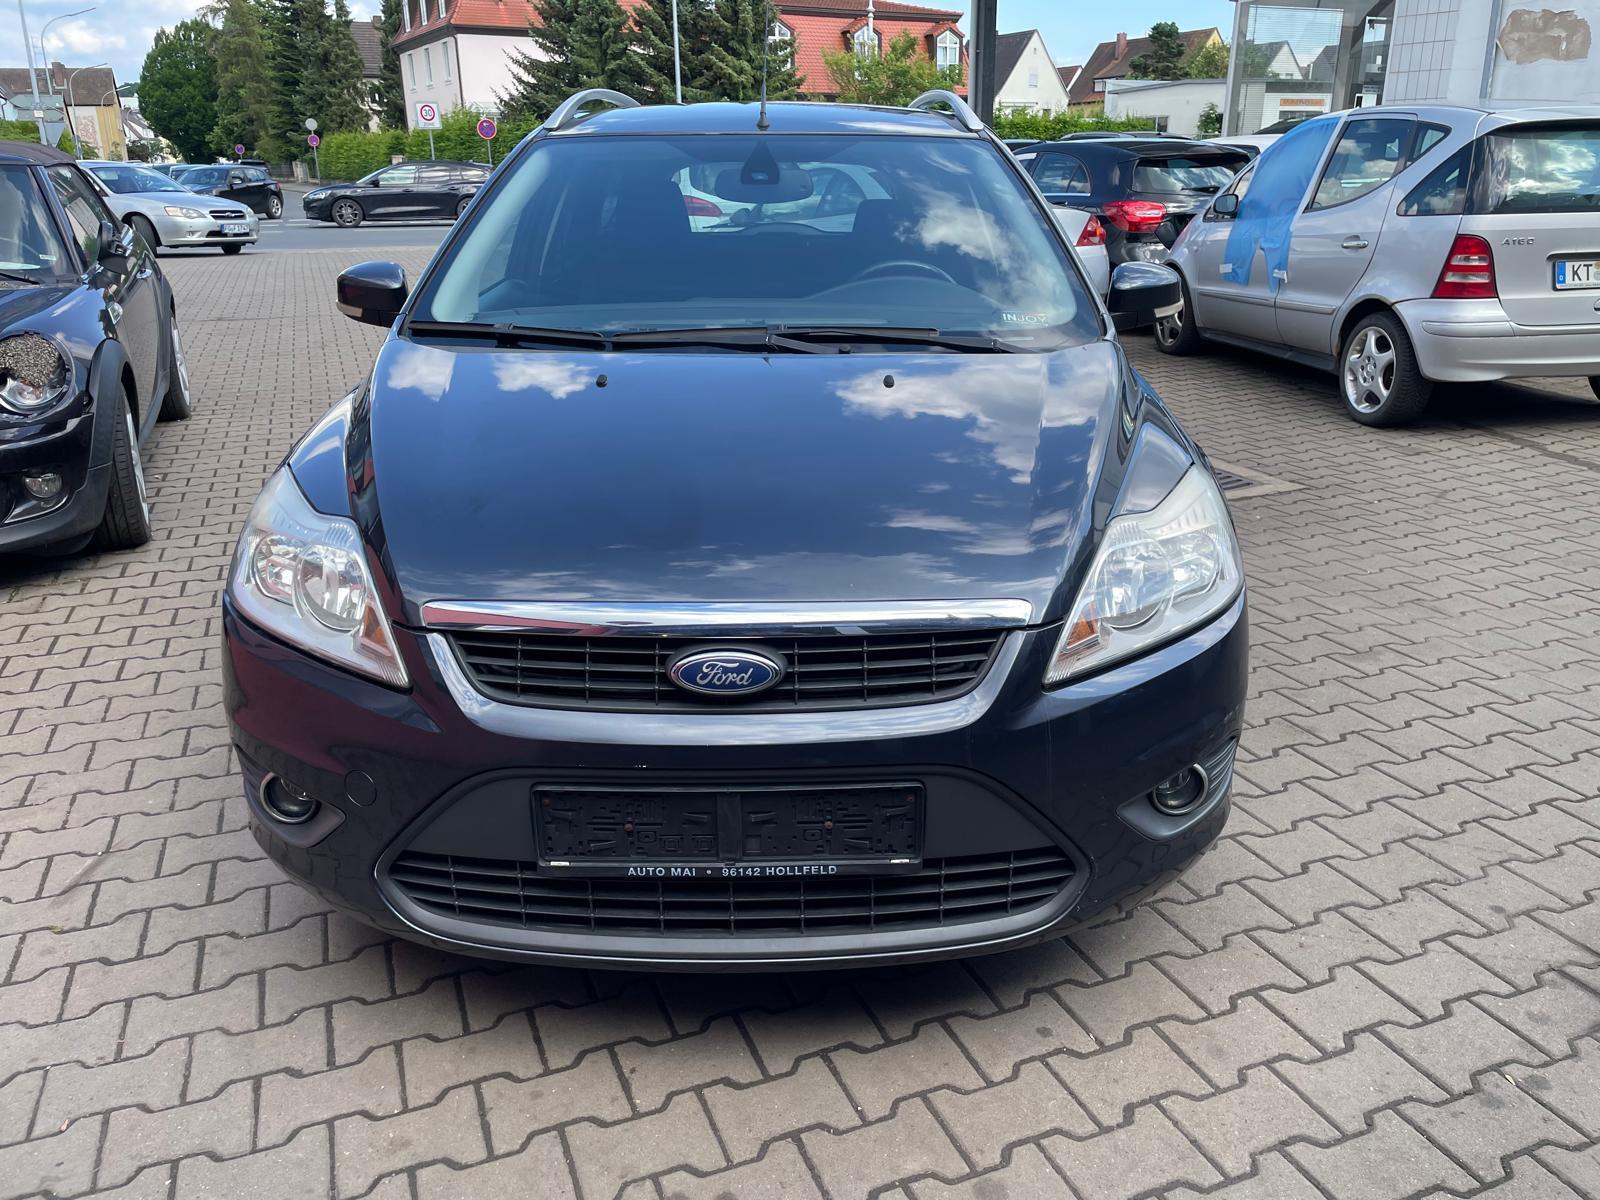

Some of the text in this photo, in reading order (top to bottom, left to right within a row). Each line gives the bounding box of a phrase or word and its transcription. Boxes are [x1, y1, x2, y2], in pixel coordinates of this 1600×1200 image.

[423, 109, 432, 117] 30
[1572, 264, 1593, 281] KT
[1002, 313, 1047, 324] INJOY
[696, 661, 754, 686] Ford
[627, 865, 837, 877] AUTO MAI 96142 HOLLFELD
